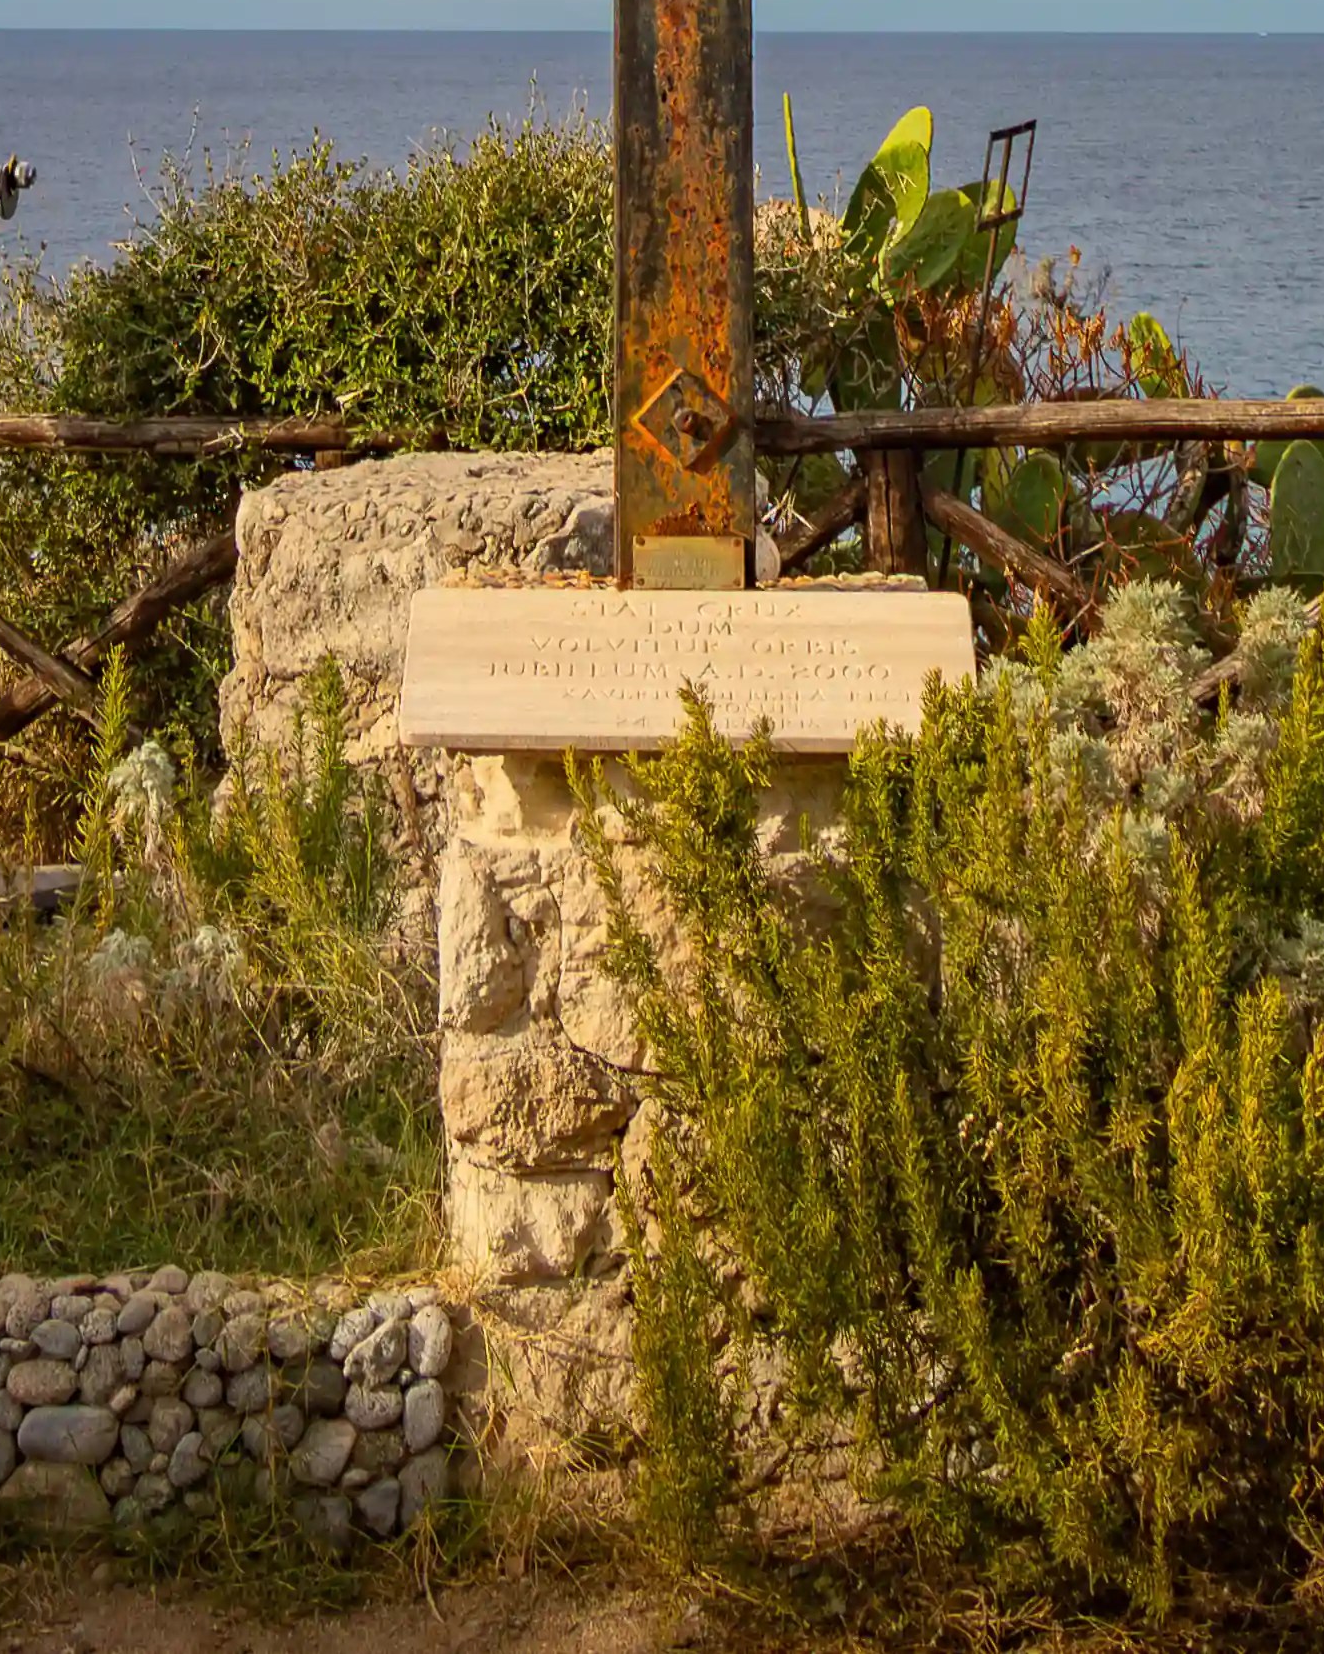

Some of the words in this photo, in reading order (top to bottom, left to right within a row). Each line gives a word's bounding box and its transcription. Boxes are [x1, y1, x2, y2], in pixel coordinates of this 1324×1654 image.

[570, 600, 659, 617] STAT
[696, 601, 804, 618] CRUX
[647, 620, 732, 636] DUM
[529, 637, 721, 654] VOLVITUR
[750, 639, 858, 655] ORBIS
[790, 664, 889, 681] 2000
[561, 688, 681, 701] XAVERIU
